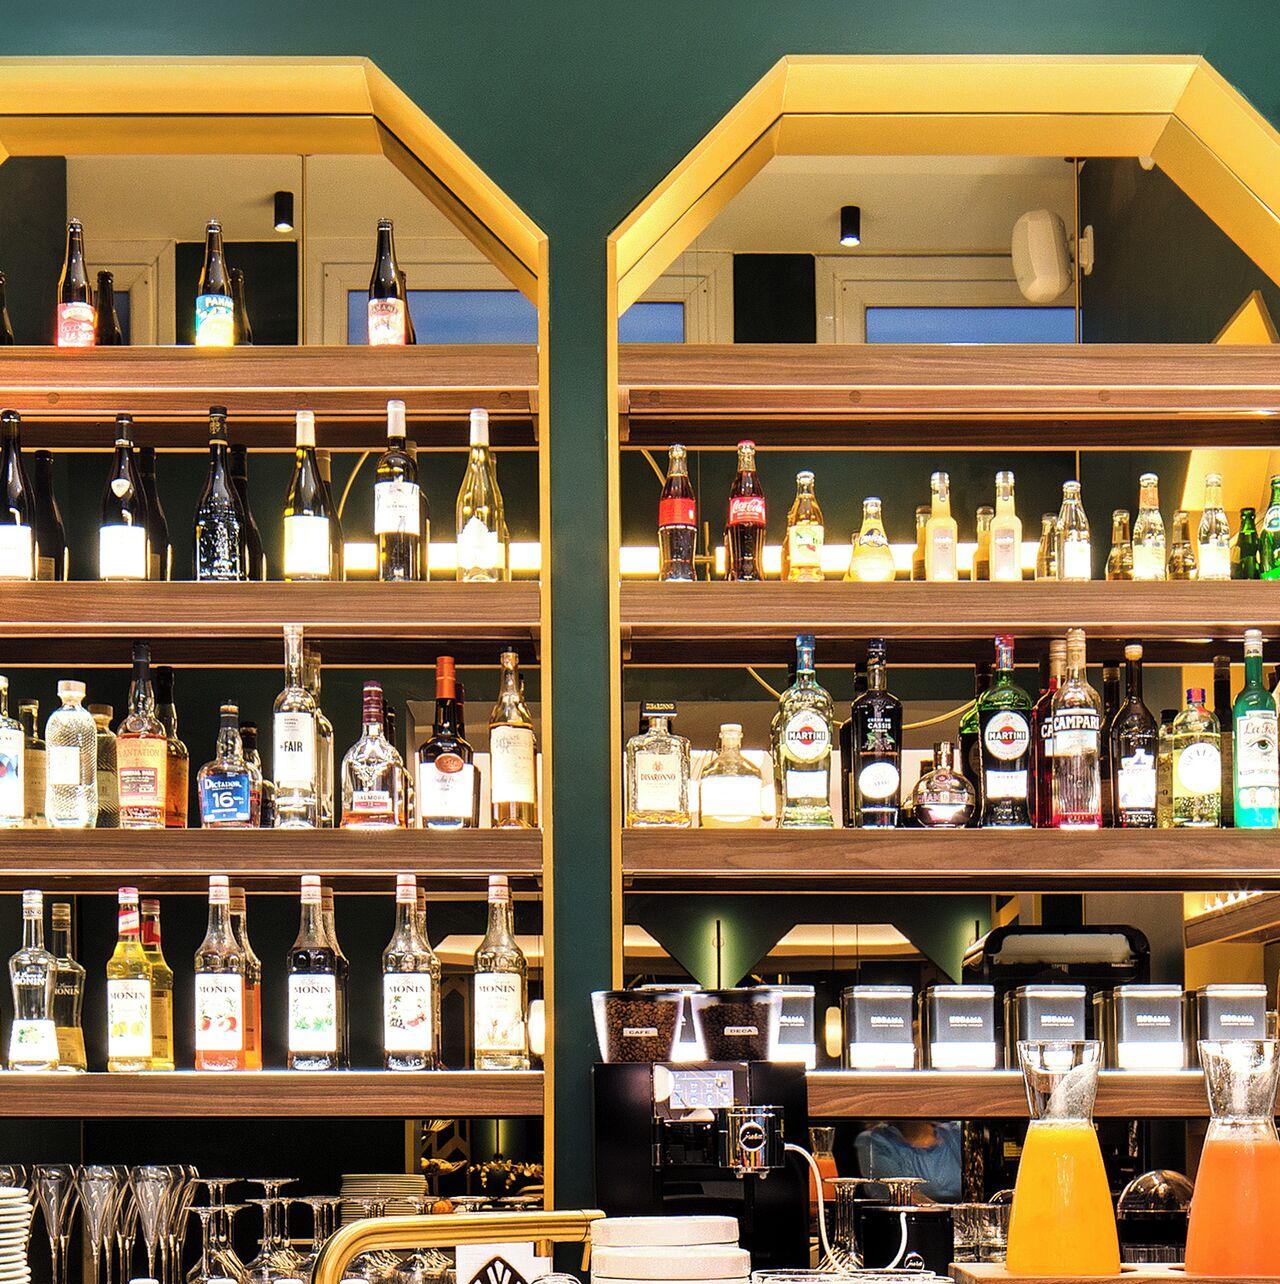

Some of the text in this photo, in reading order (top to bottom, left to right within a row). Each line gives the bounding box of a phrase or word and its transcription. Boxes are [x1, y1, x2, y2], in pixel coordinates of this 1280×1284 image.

[867, 722, 892, 730] CASSIS
[1052, 714, 1101, 732] CAMPARI
[787, 731, 826, 741] MARTINI
[987, 731, 1027, 741] MARTINI
[283, 740, 304, 753] FAIR
[211, 791, 235, 808] 16
[199, 985, 236, 993] MONIN
[294, 985, 331, 994] MONIN
[478, 985, 516, 993] MONIN
